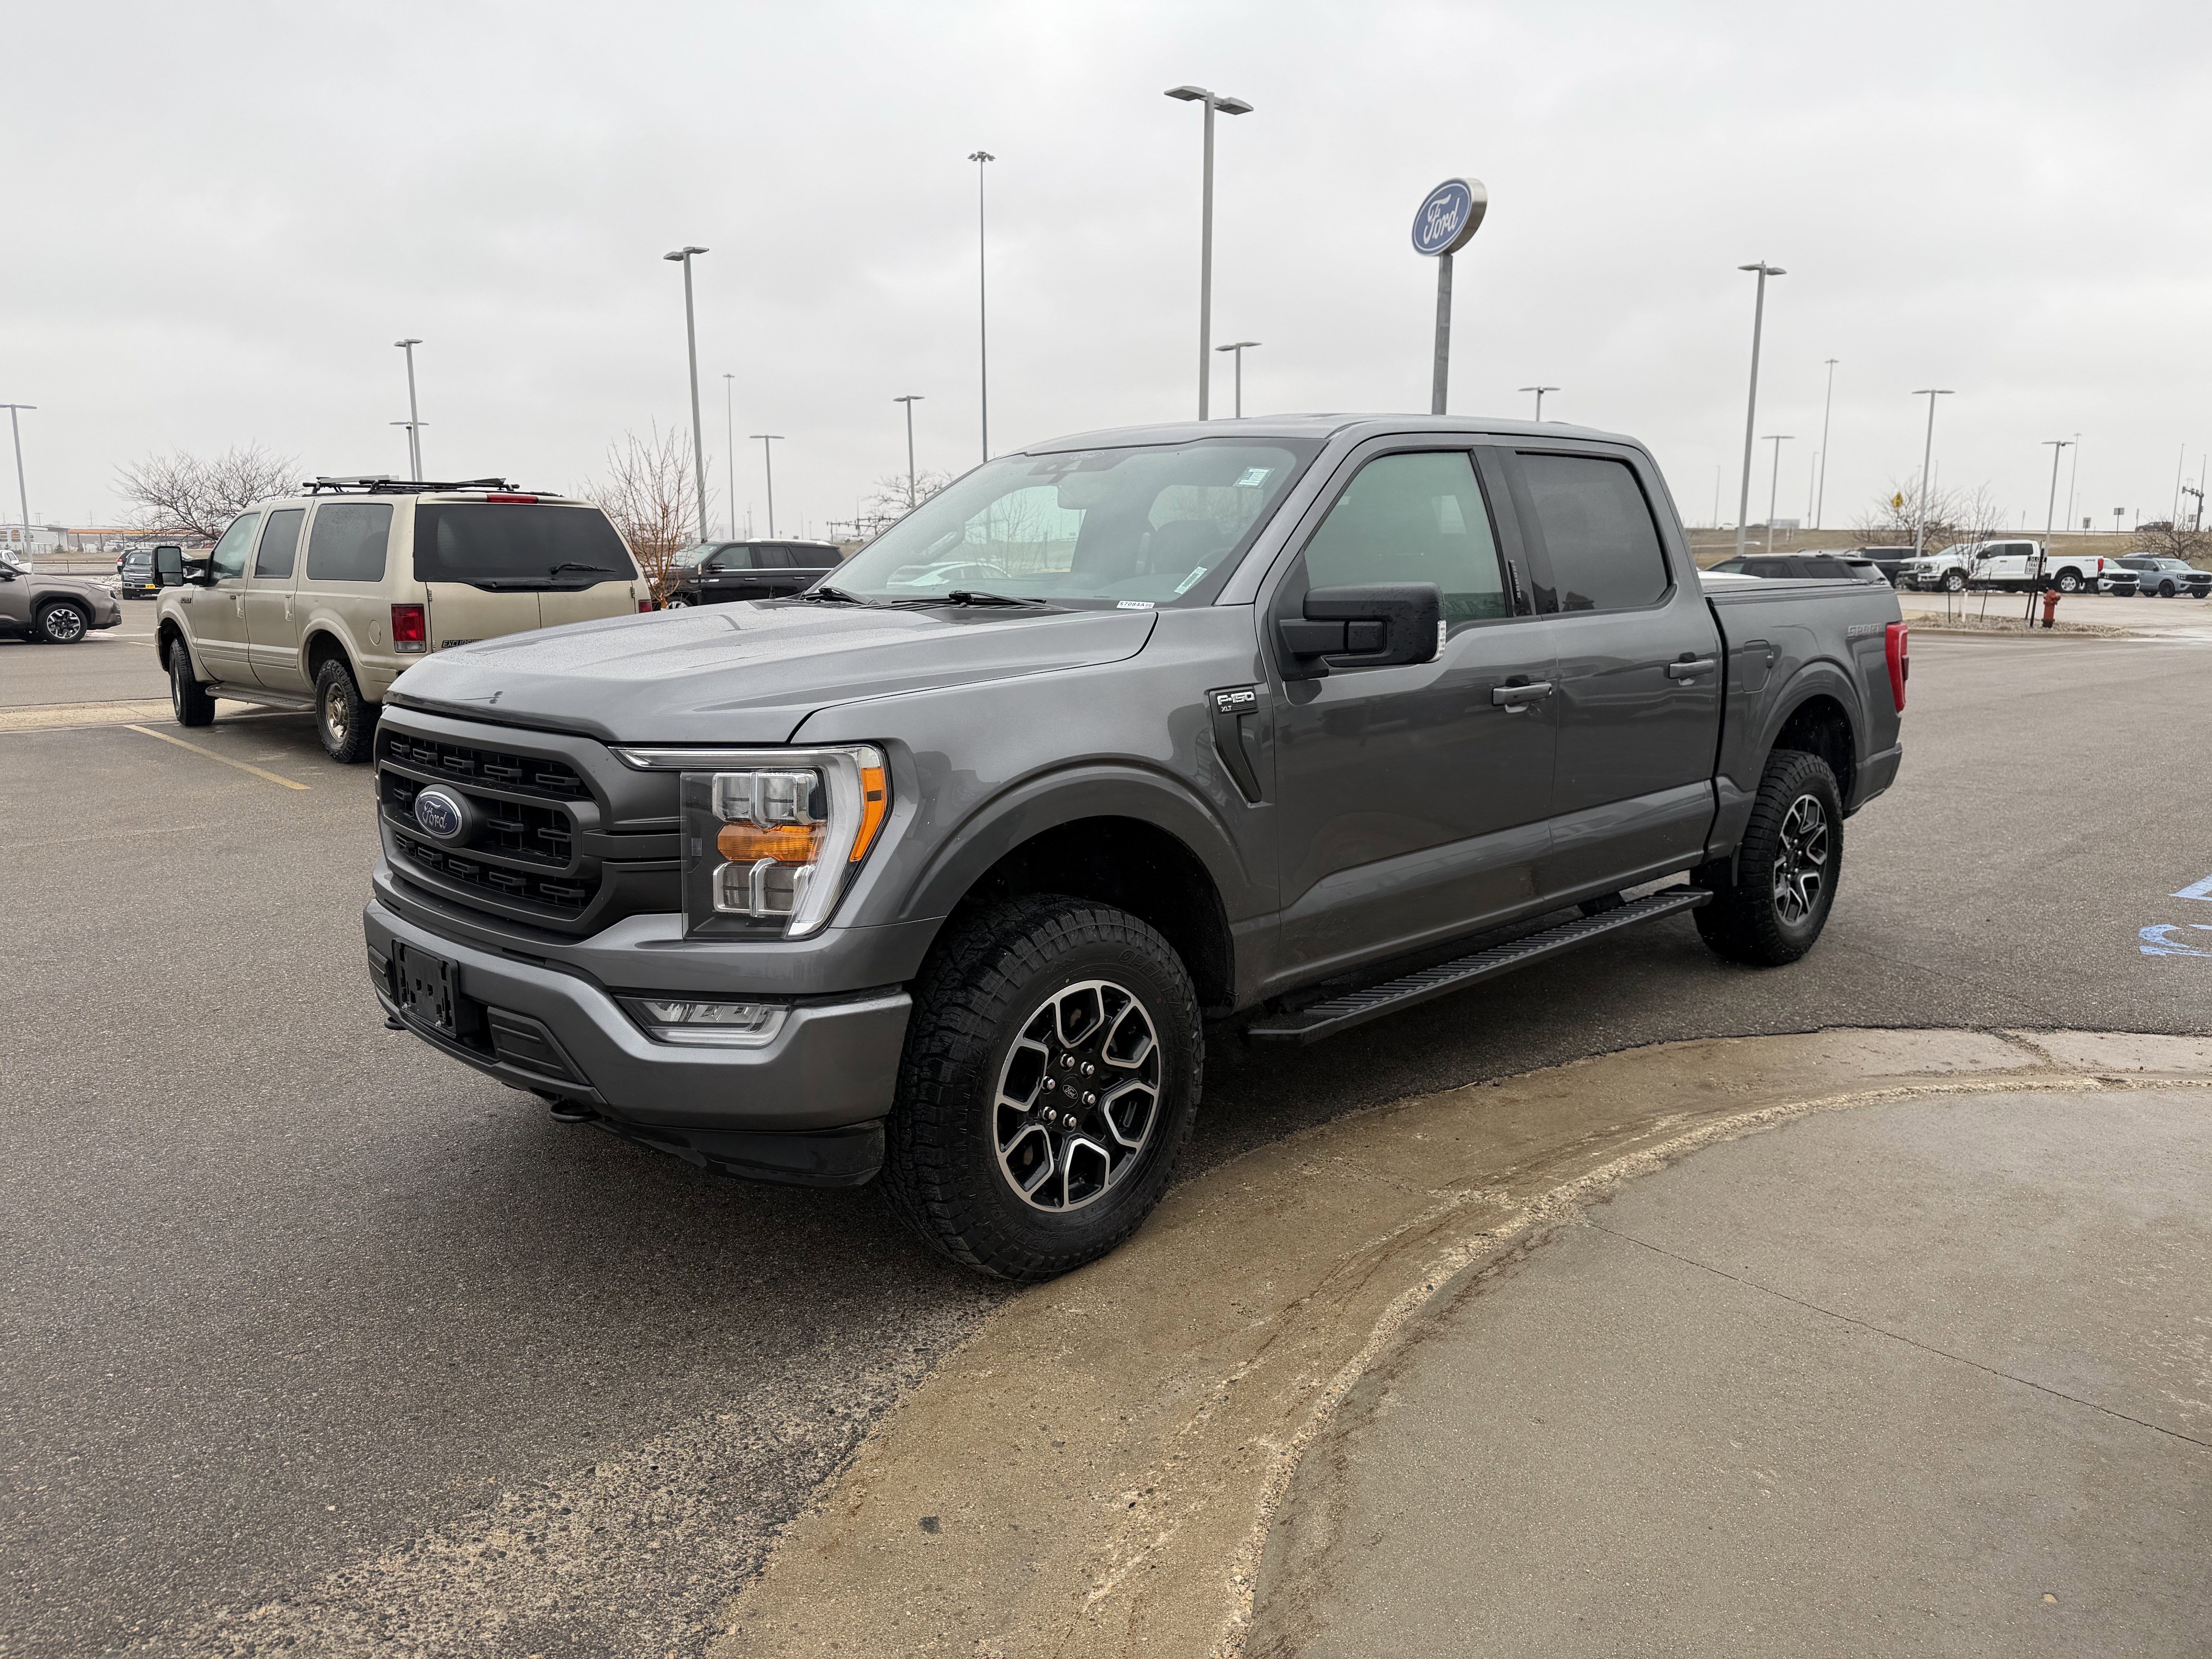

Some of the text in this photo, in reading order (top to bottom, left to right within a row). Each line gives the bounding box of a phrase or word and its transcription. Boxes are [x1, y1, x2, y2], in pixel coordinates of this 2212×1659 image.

[1423, 194, 1460, 245] Ford
[1847, 623, 1882, 638] SPORT
[1217, 691, 1255, 705] F-150
[422, 800, 447, 830] Ford
[1118, 949, 1167, 985] OPEN
[1065, 1087, 1076, 1097] Ford
